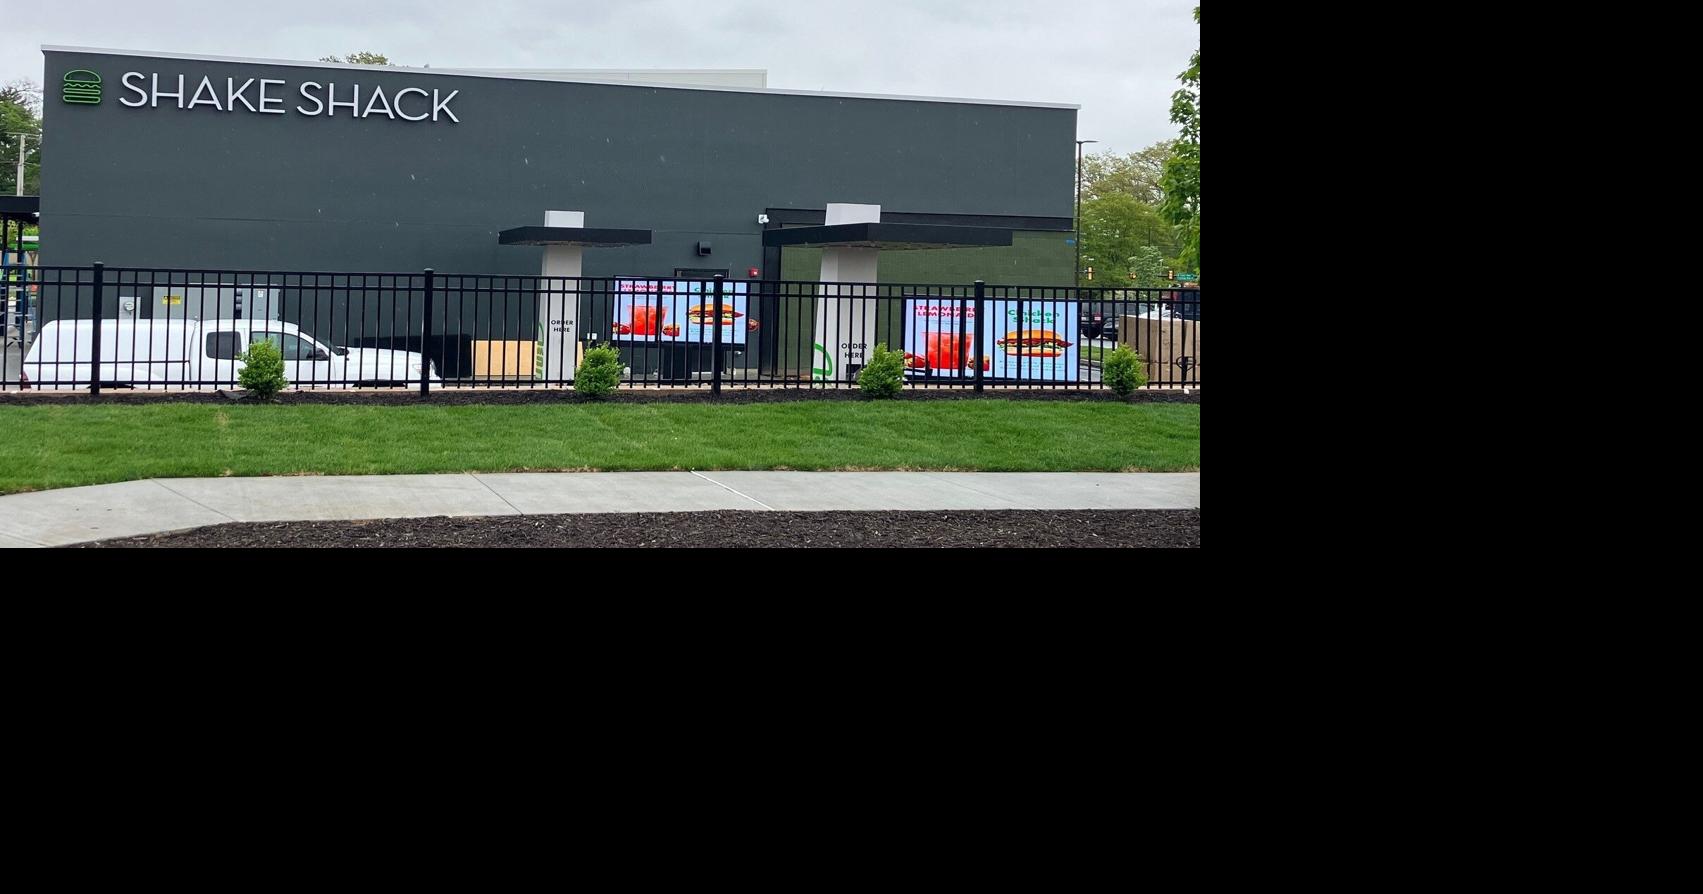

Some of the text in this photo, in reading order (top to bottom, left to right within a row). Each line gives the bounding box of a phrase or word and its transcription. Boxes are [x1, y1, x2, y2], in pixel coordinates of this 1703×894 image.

[119, 71, 460, 123] SHAKE SHACK
[1008, 309, 1060, 317] Ccken
[841, 342, 868, 350] ODER
